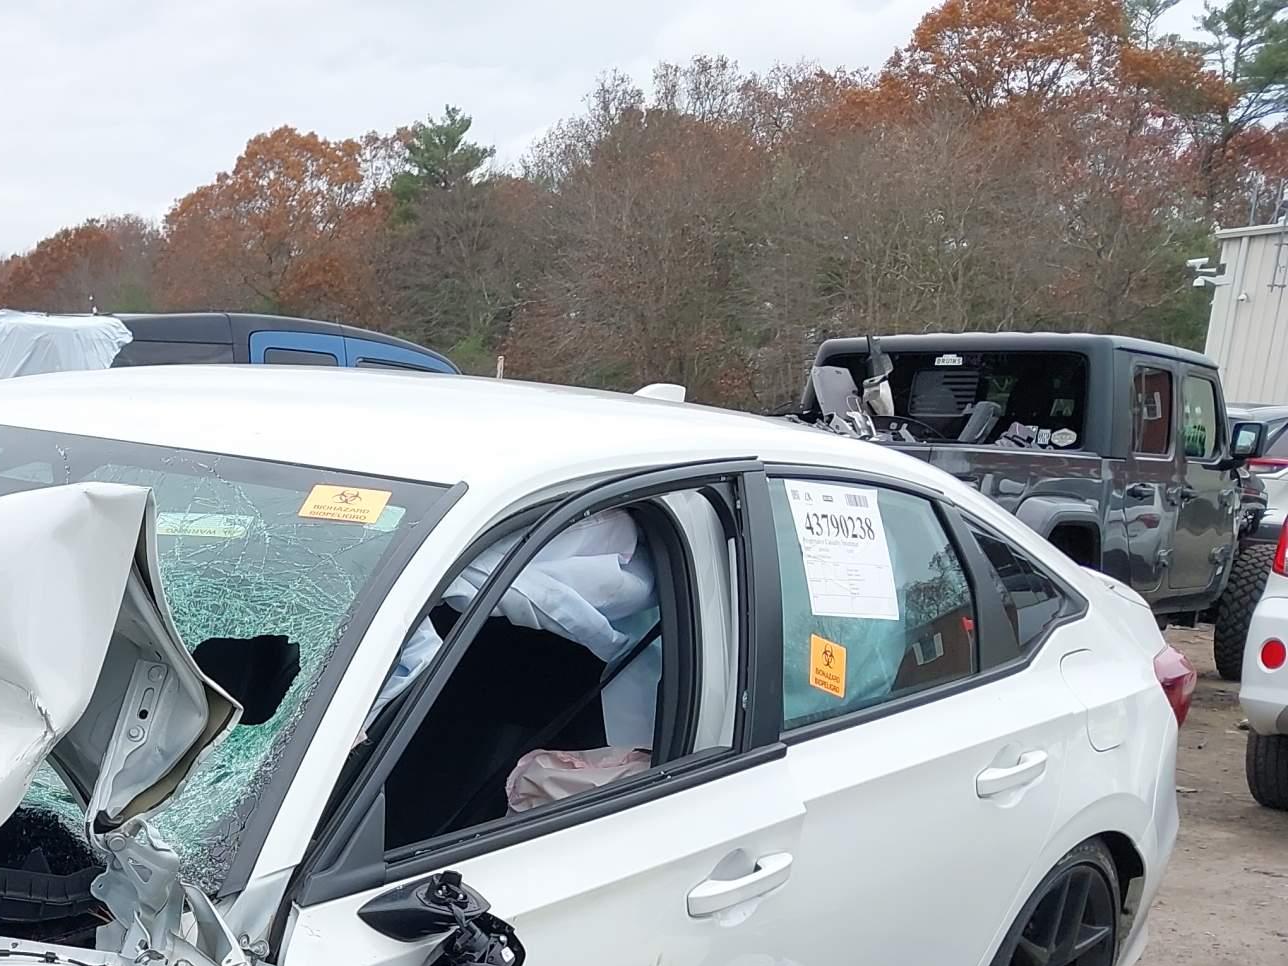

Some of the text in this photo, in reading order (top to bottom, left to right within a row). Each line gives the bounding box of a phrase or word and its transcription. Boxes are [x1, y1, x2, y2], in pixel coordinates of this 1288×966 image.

[309, 510, 367, 521] BIOPELIGRO
[313, 504, 371, 514] BIOHAZARD
[805, 512, 875, 541] 43790238
[815, 667, 841, 684] BIOHAZARD
[814, 677, 840, 694] BIOPELIGRO
